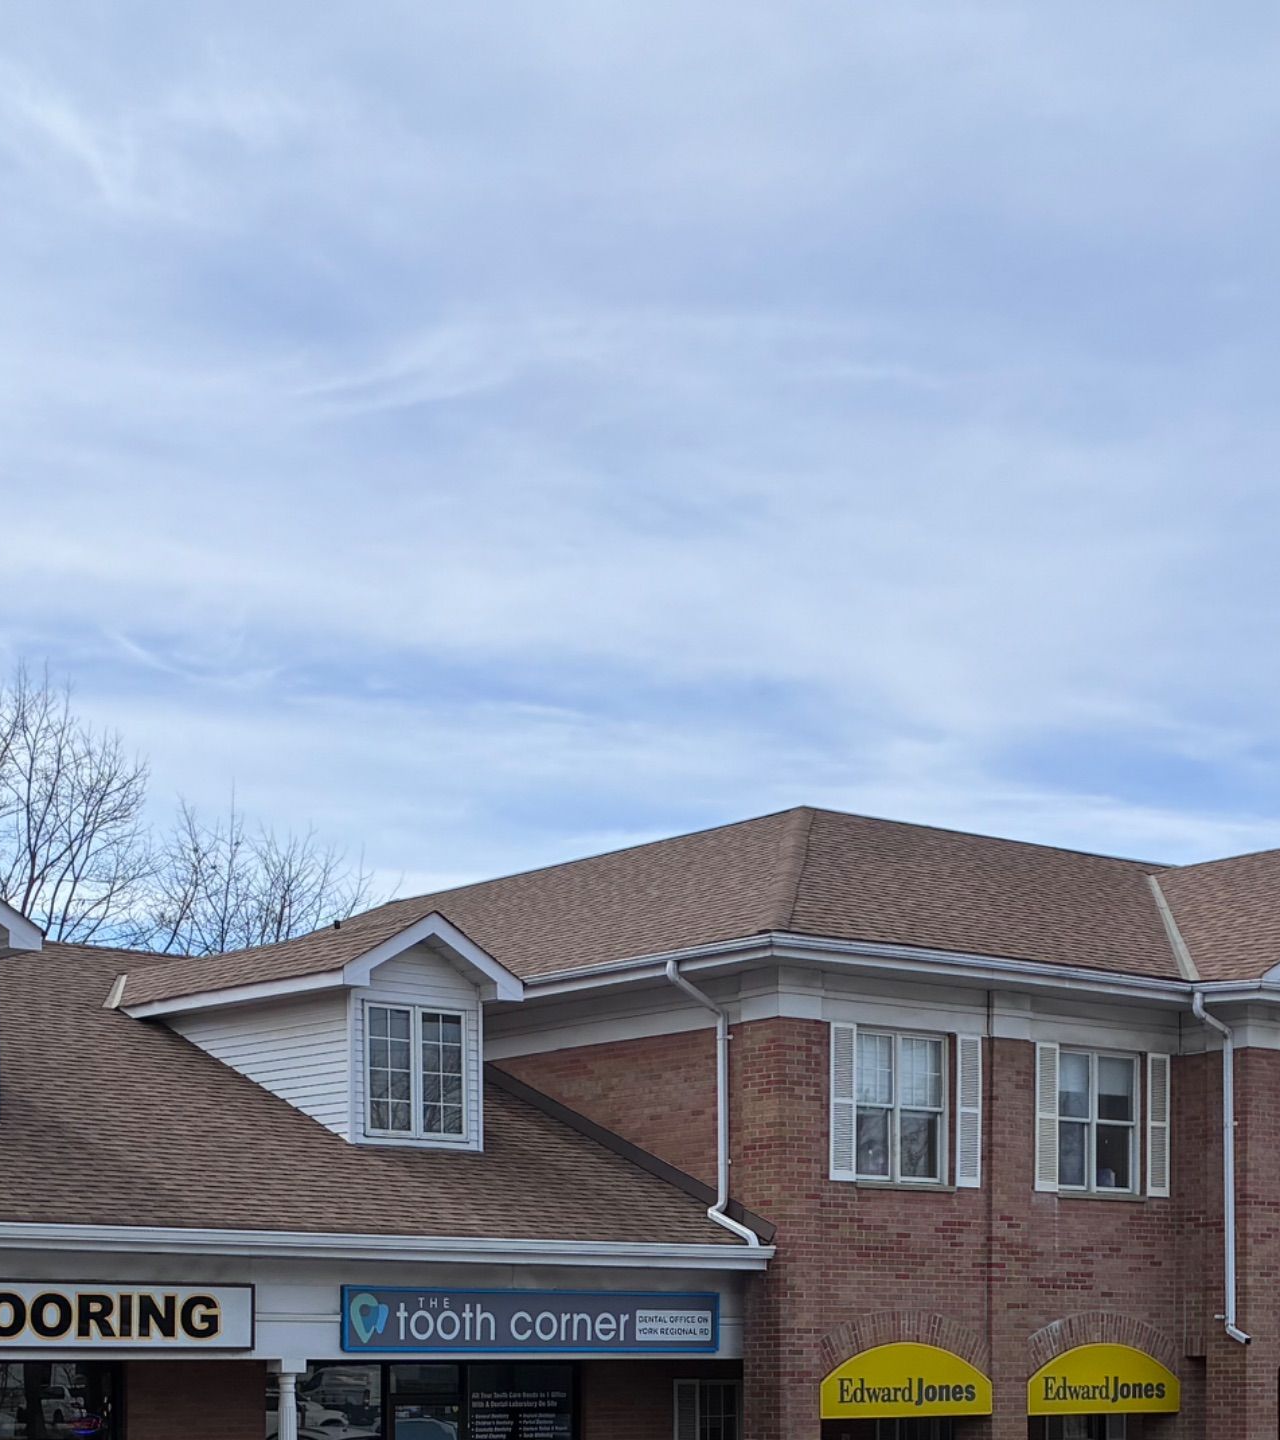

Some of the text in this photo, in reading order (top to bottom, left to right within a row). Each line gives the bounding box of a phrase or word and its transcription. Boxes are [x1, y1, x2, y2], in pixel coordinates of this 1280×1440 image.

[418, 1296, 450, 1309] THE
[396, 1302, 630, 1342] tooth corner
